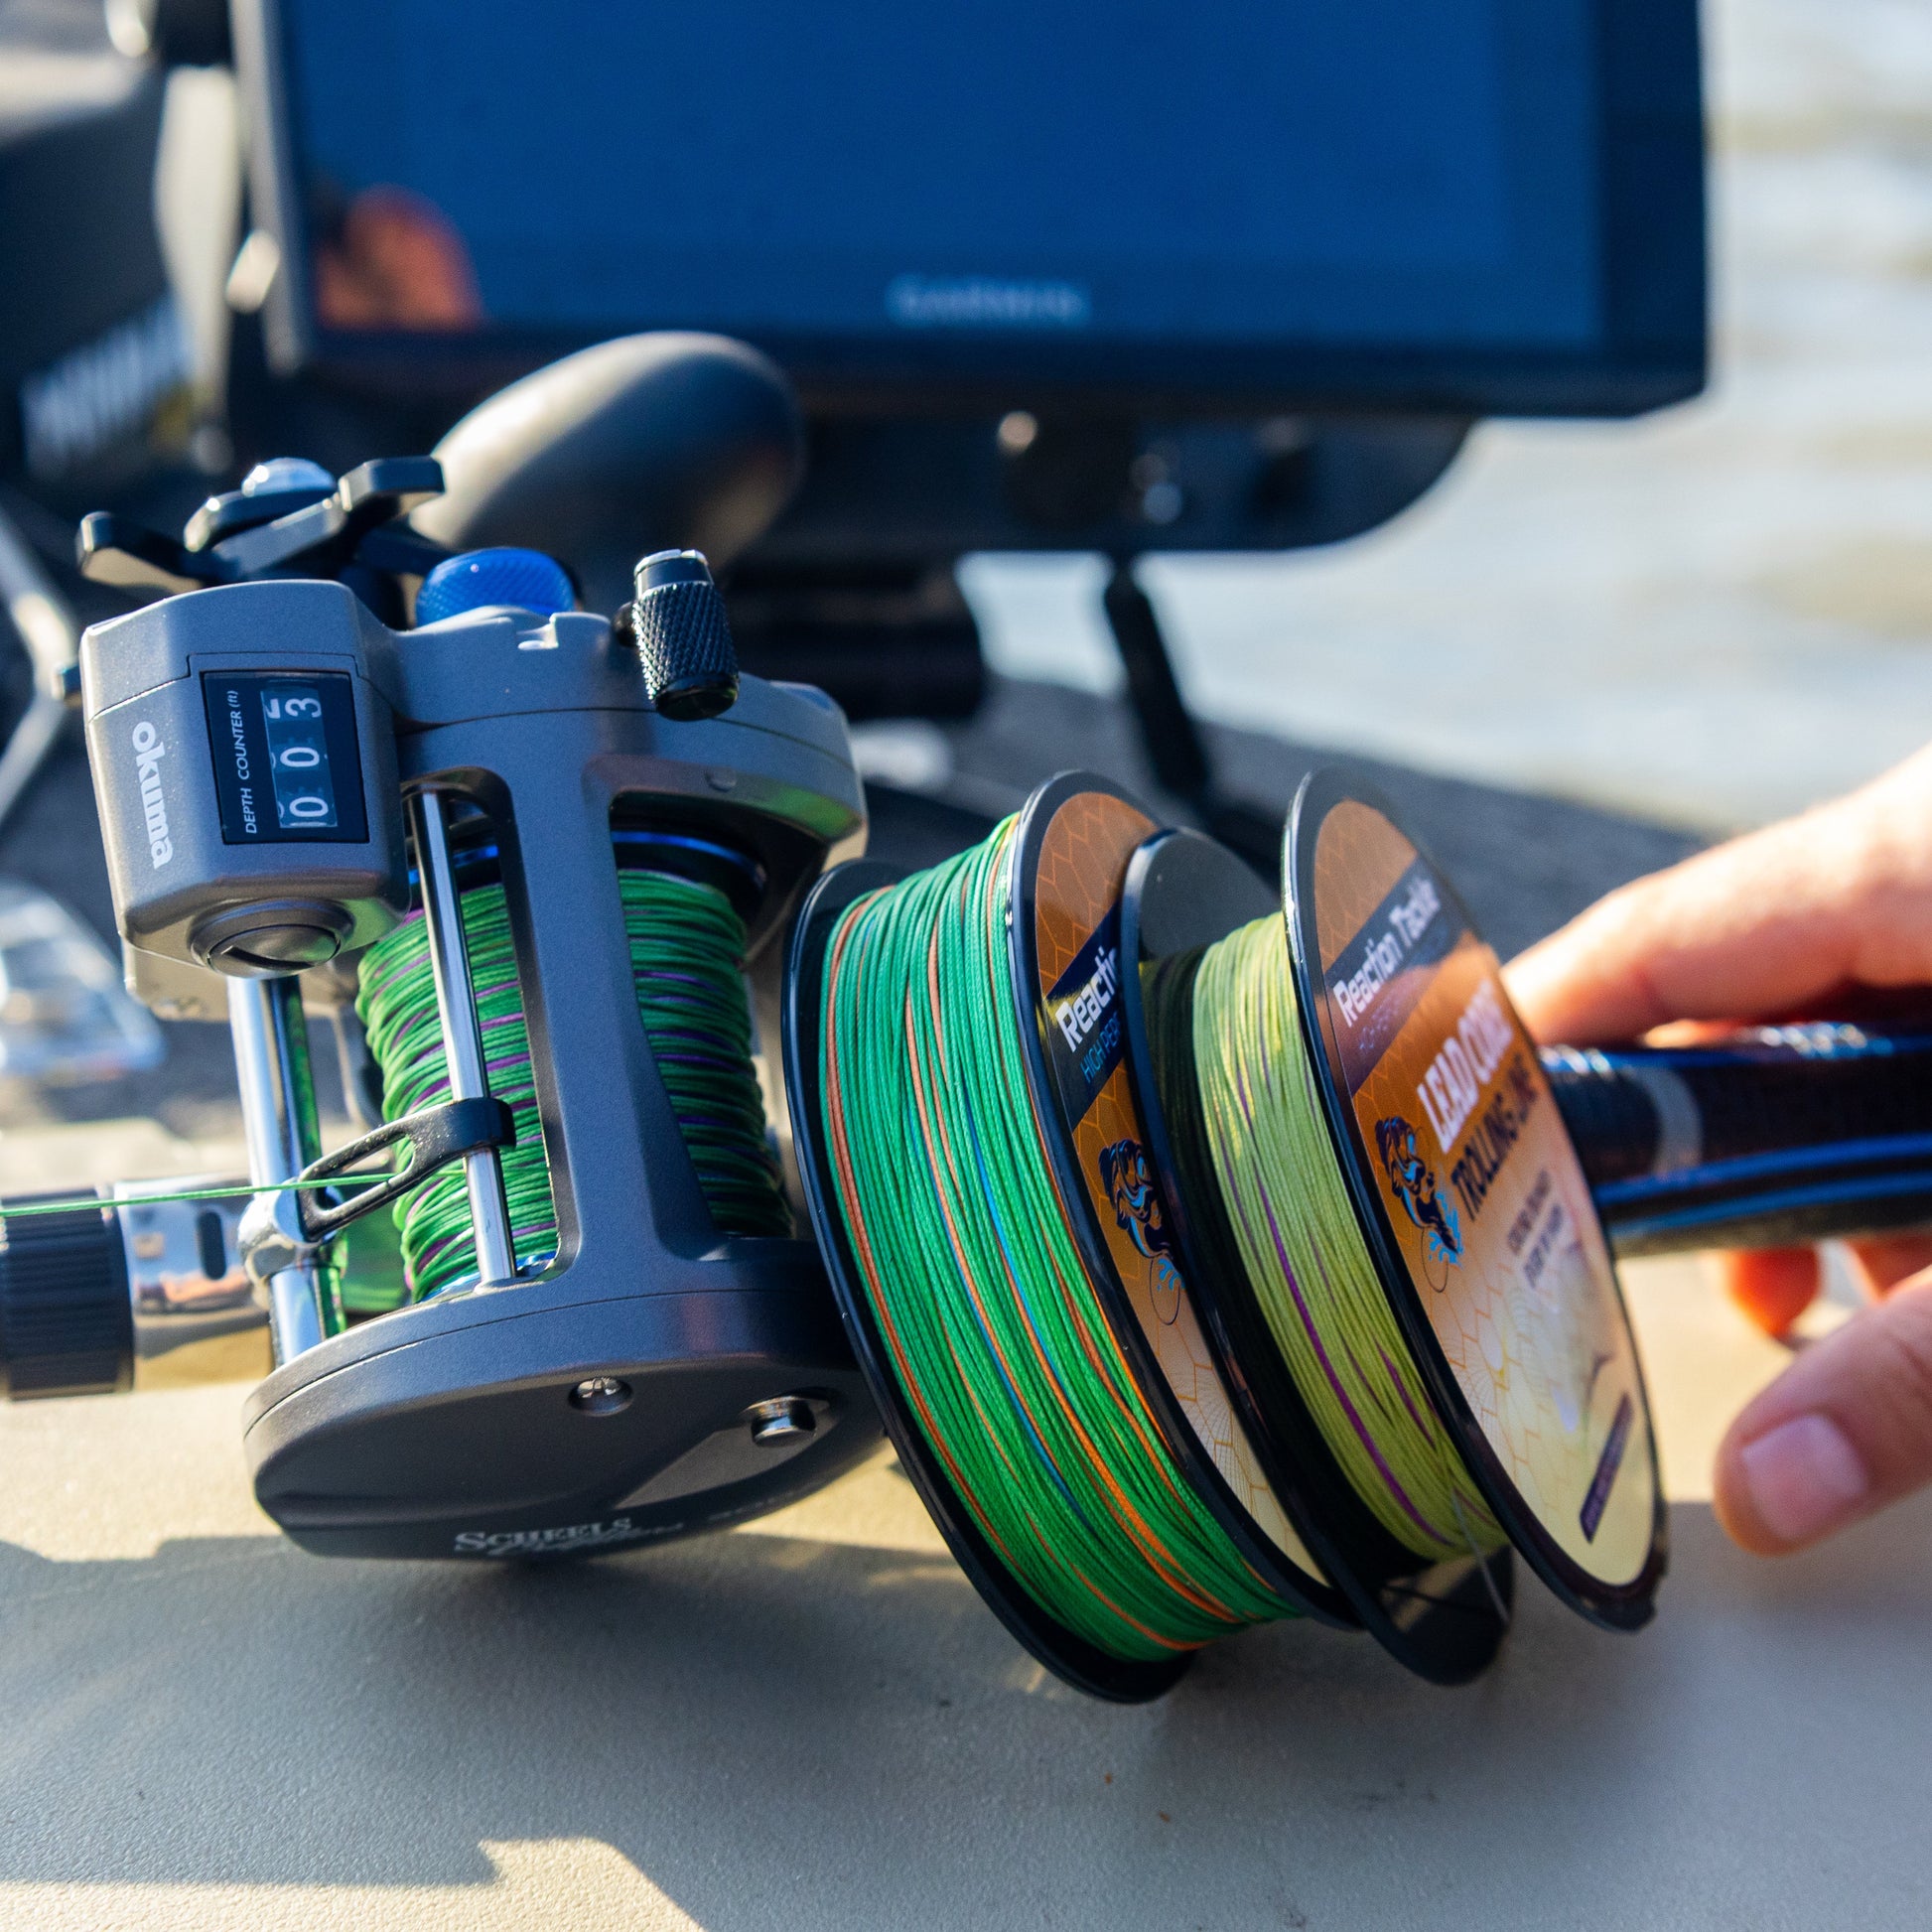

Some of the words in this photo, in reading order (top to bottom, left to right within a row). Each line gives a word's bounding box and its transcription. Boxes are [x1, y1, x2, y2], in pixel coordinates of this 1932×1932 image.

[229, 710, 250, 780] COUNTER
[132, 721, 174, 870] okuma
[240, 787, 256, 835] DEPTH
[1333, 931, 1404, 1028] Reaction
[1080, 1038, 1107, 1084] HIGH
[1417, 1036, 1479, 1155] LEAD
[454, 1517, 631, 1553] SCHEELS
